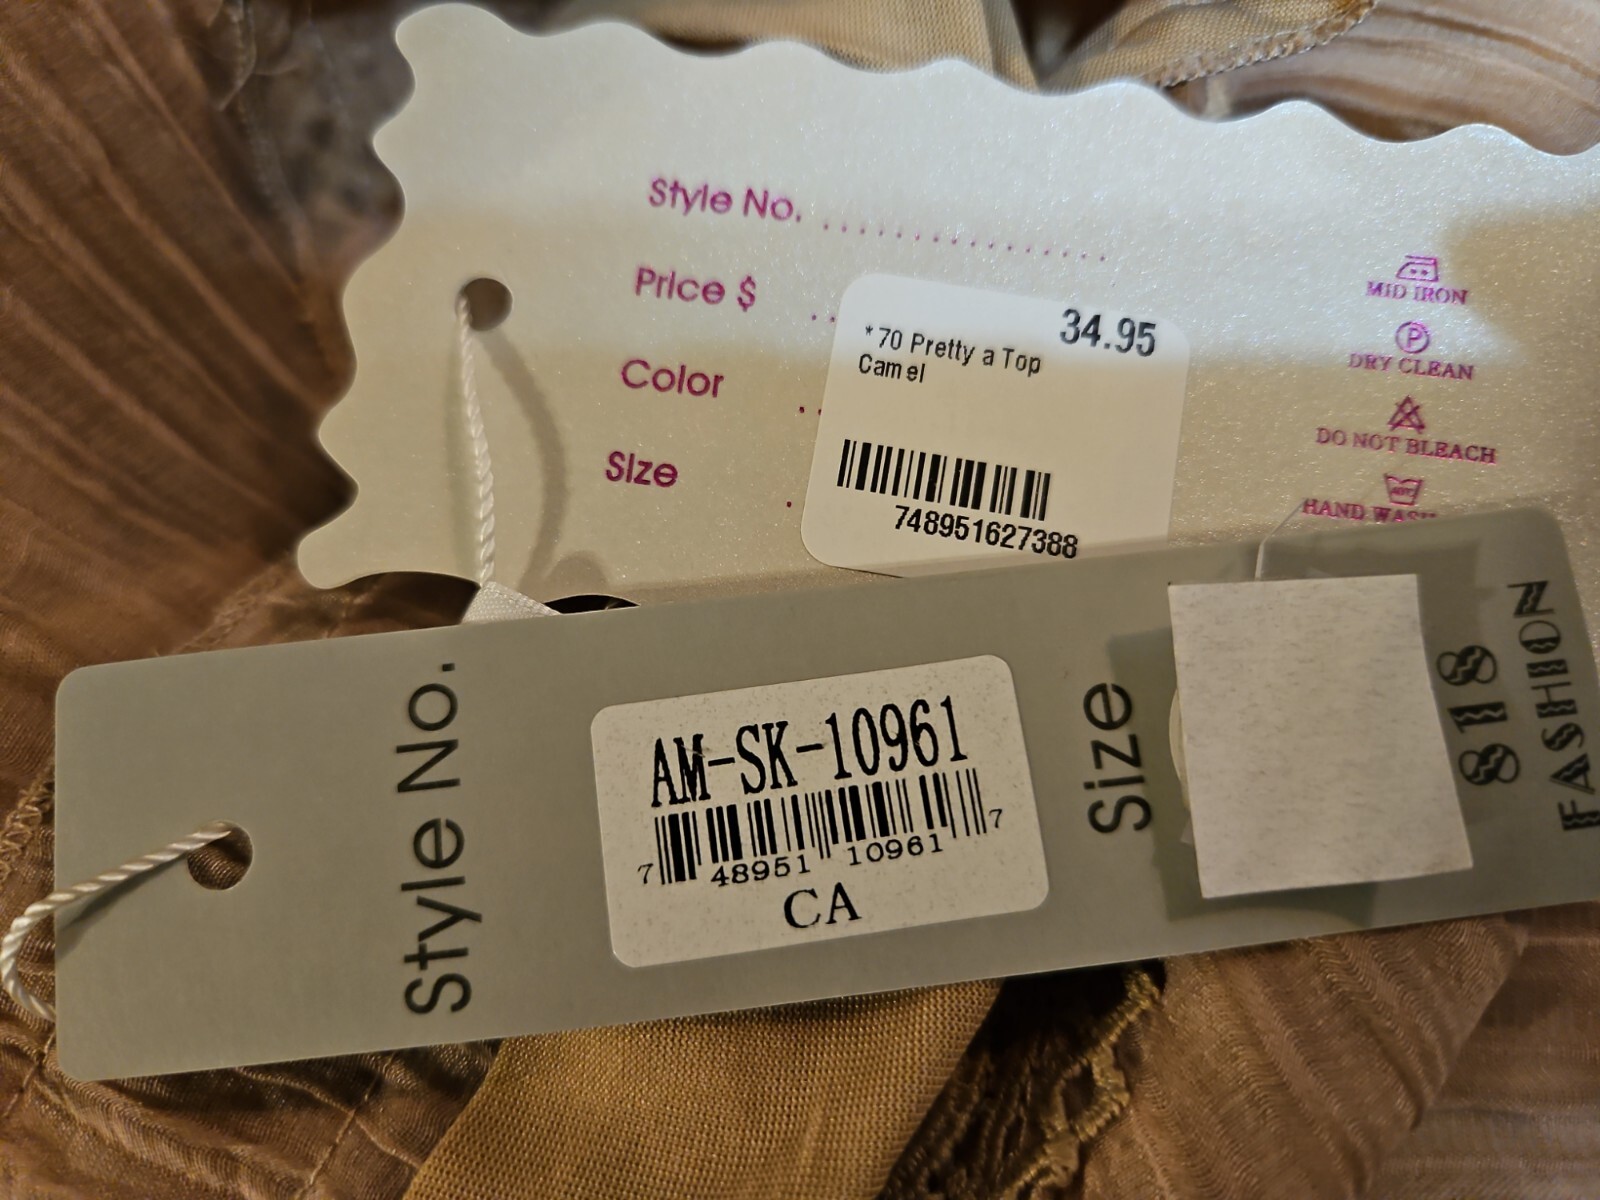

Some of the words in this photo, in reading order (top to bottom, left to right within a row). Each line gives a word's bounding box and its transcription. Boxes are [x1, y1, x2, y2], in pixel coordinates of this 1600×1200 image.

[647, 177, 732, 216] Style
[743, 188, 802, 223] No.
[634, 266, 726, 304] Price
[737, 275, 757, 311] $
[1366, 281, 1407, 299] MID
[1414, 286, 1468, 305] IRON
[910, 333, 975, 366] Pretty
[982, 349, 994, 366] a
[1002, 348, 1041, 377] Top
[1060, 308, 1156, 357] 34.95
[621, 358, 724, 398] Color
[1348, 353, 1392, 372] DRY
[1398, 357, 1474, 381] CLEAN
[604, 450, 678, 488] Size
[1316, 427, 1347, 446] DO
[1352, 433, 1400, 453] NOT
[1405, 438, 1497, 465] BLEACH
[894, 504, 1079, 559] 748951627388
[1302, 498, 1365, 520] HAND
[396, 662, 460, 793] No.
[1437, 644, 1520, 786] 818
[1507, 580, 1600, 831] FASHION
[651, 695, 968, 807] AM-SK-10961
[1083, 682, 1152, 834] Size
[638, 864, 654, 884] 7
[710, 854, 811, 887] 48951
[847, 833, 944, 866] 10961
[988, 808, 1004, 828] 7
[401, 817, 482, 1014] Style
[783, 881, 861, 928] CA
